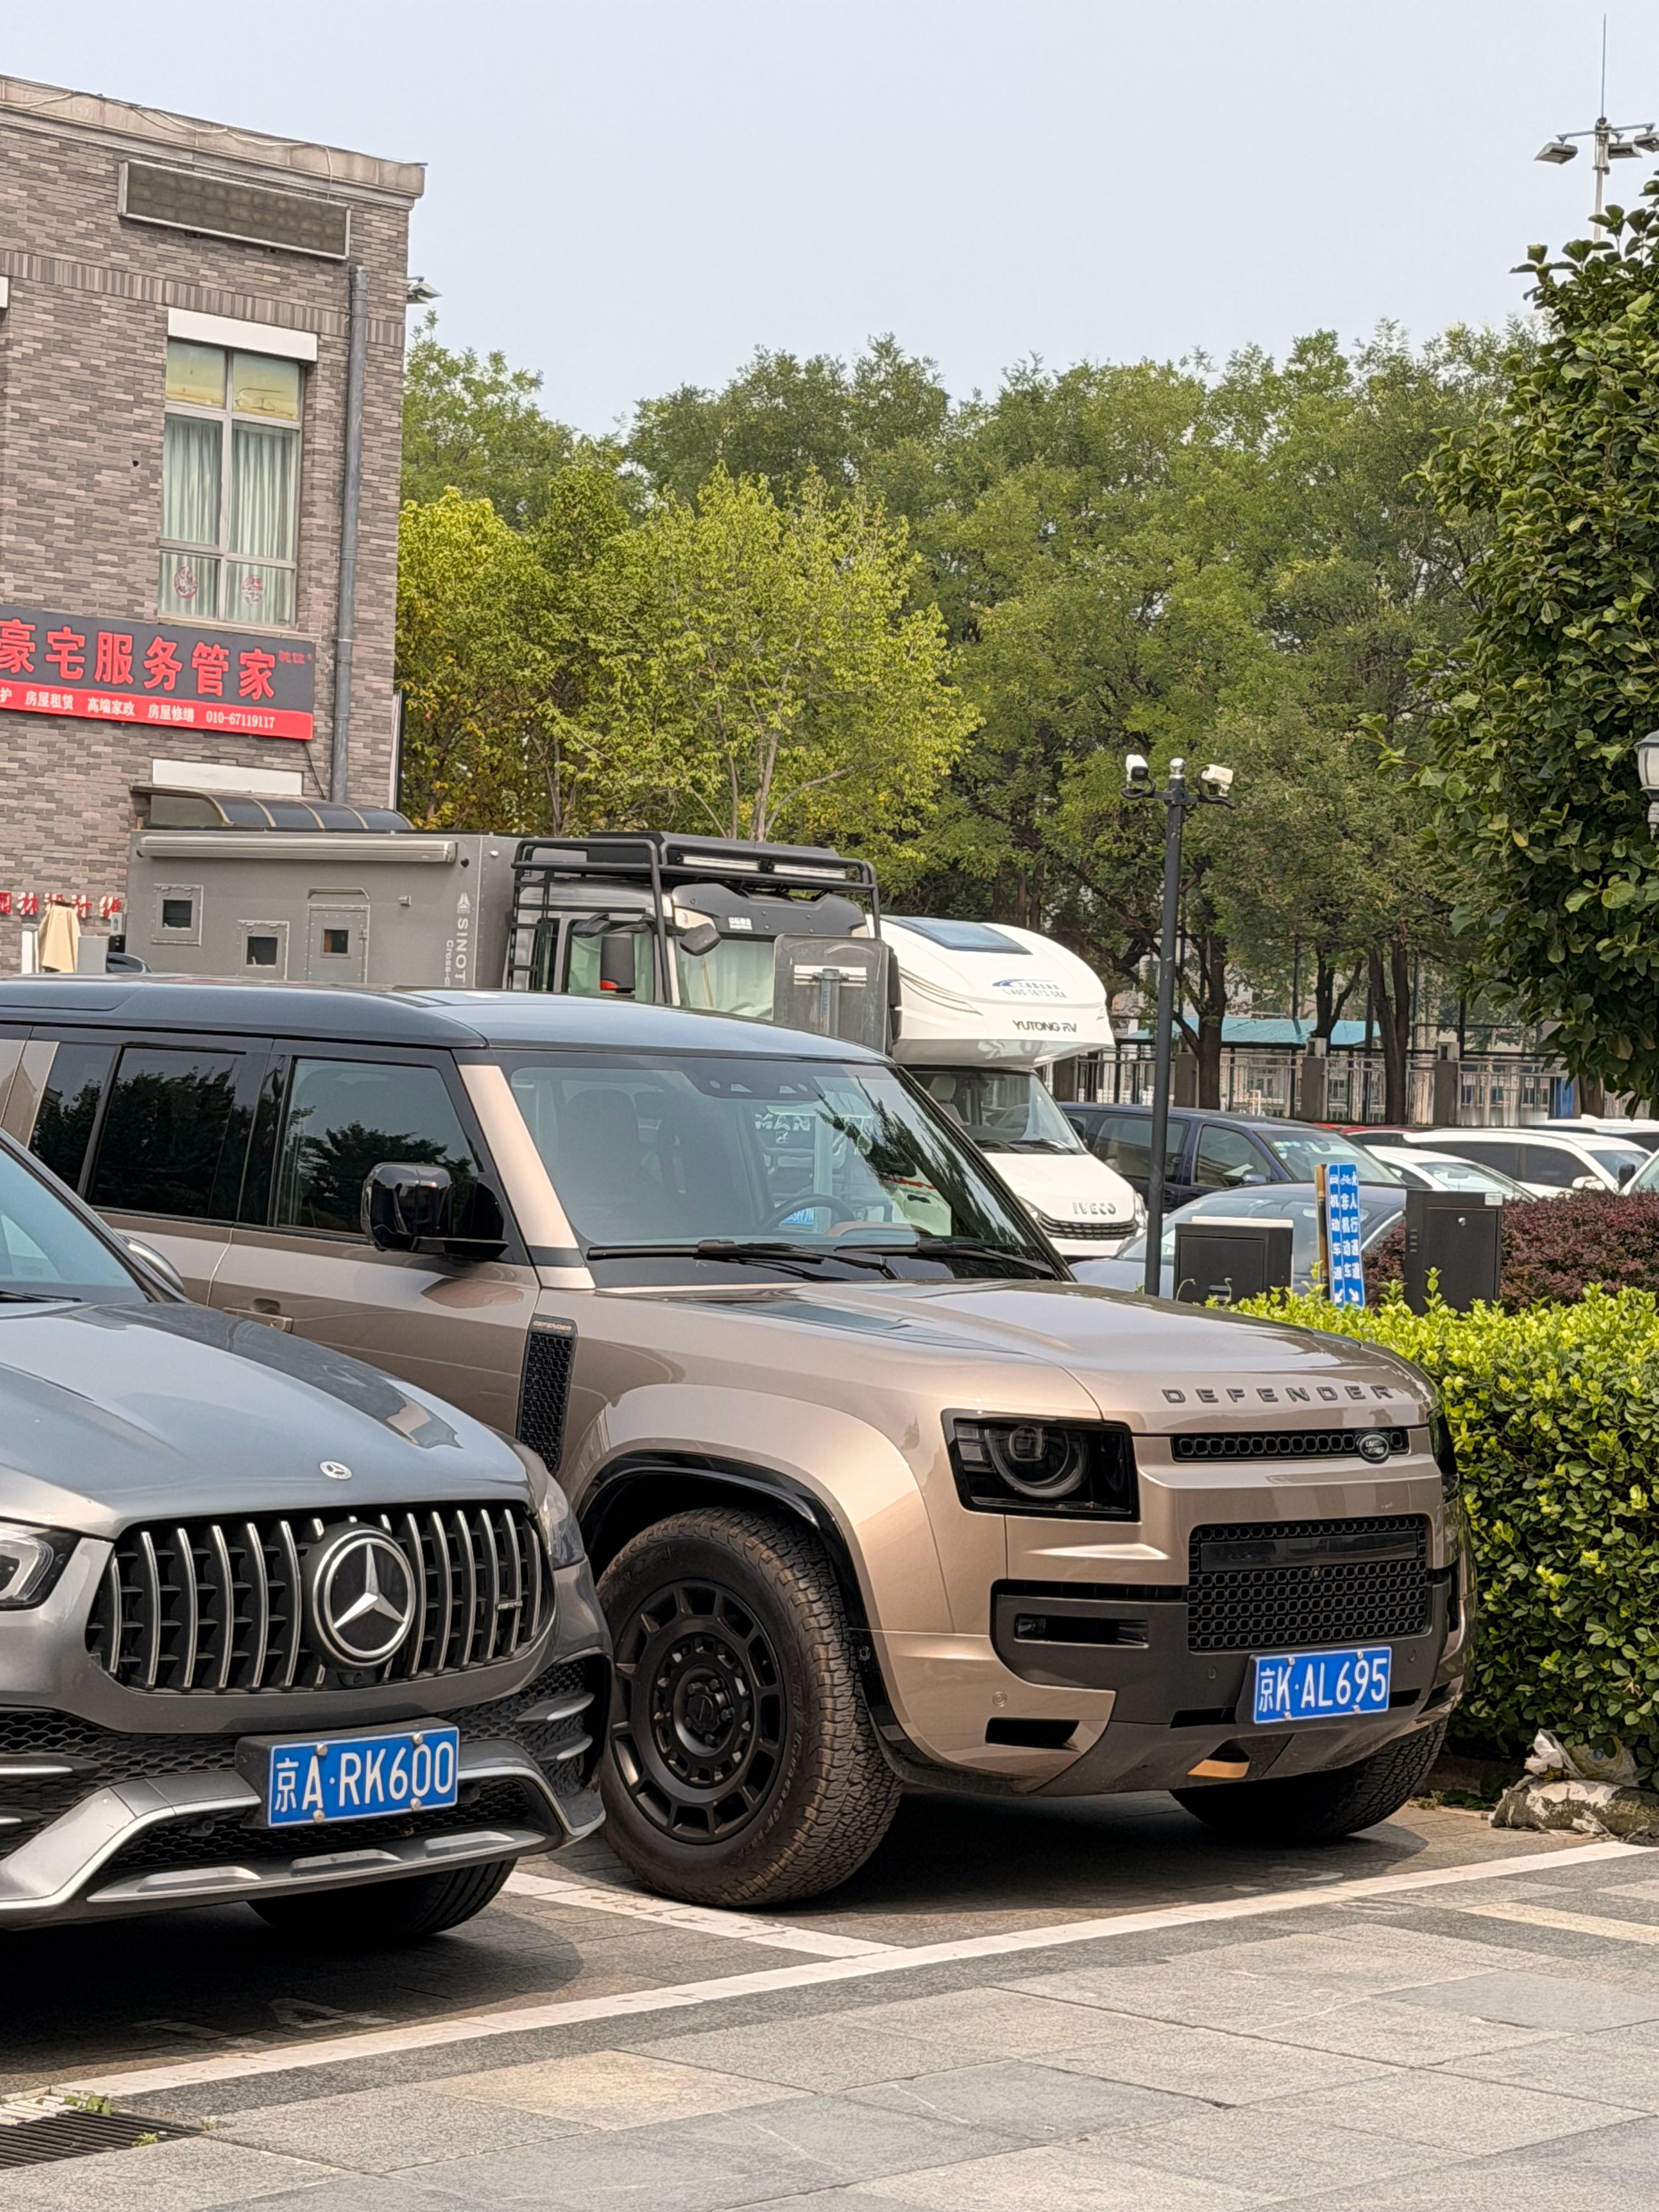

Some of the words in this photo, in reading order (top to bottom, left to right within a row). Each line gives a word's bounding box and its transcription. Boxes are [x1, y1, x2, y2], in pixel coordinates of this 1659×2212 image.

[0, 618, 276, 701] 豪宅服务管家
[25, 690, 74, 710] 房屋租赁
[87, 697, 136, 716] 高端家政
[206, 710, 275, 729] 010-67119117
[455, 917, 469, 988] SINOT
[1012, 1019, 1060, 1032] YUTONG
[1061, 1022, 1077, 1032] RV
[1071, 1202, 1116, 1215] IVECO
[1161, 1384, 1393, 1404] DEFENDER
